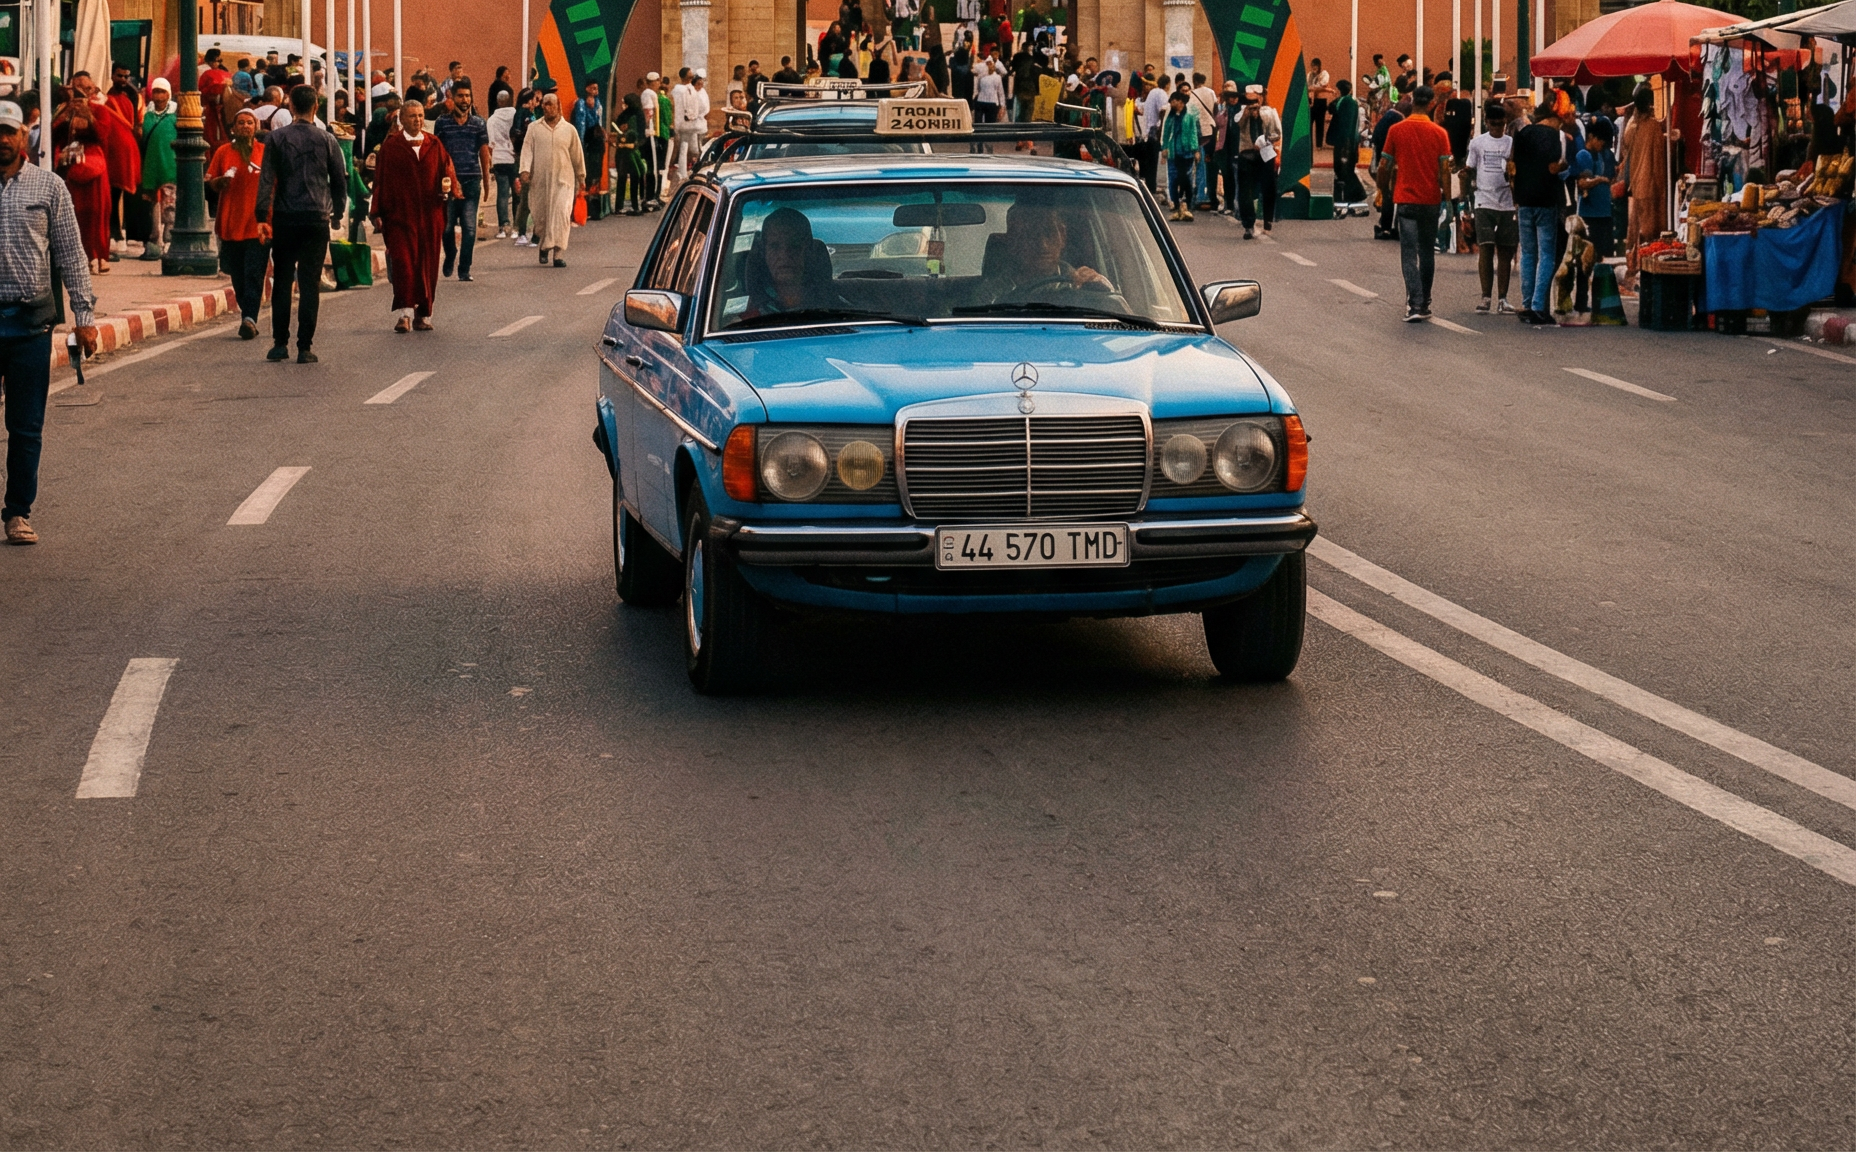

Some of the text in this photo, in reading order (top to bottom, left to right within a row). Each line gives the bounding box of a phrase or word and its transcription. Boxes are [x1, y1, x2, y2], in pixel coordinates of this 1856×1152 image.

[961, 533, 994, 561] 44
[1006, 532, 1055, 560] 570
[1067, 531, 1118, 559] TMD
